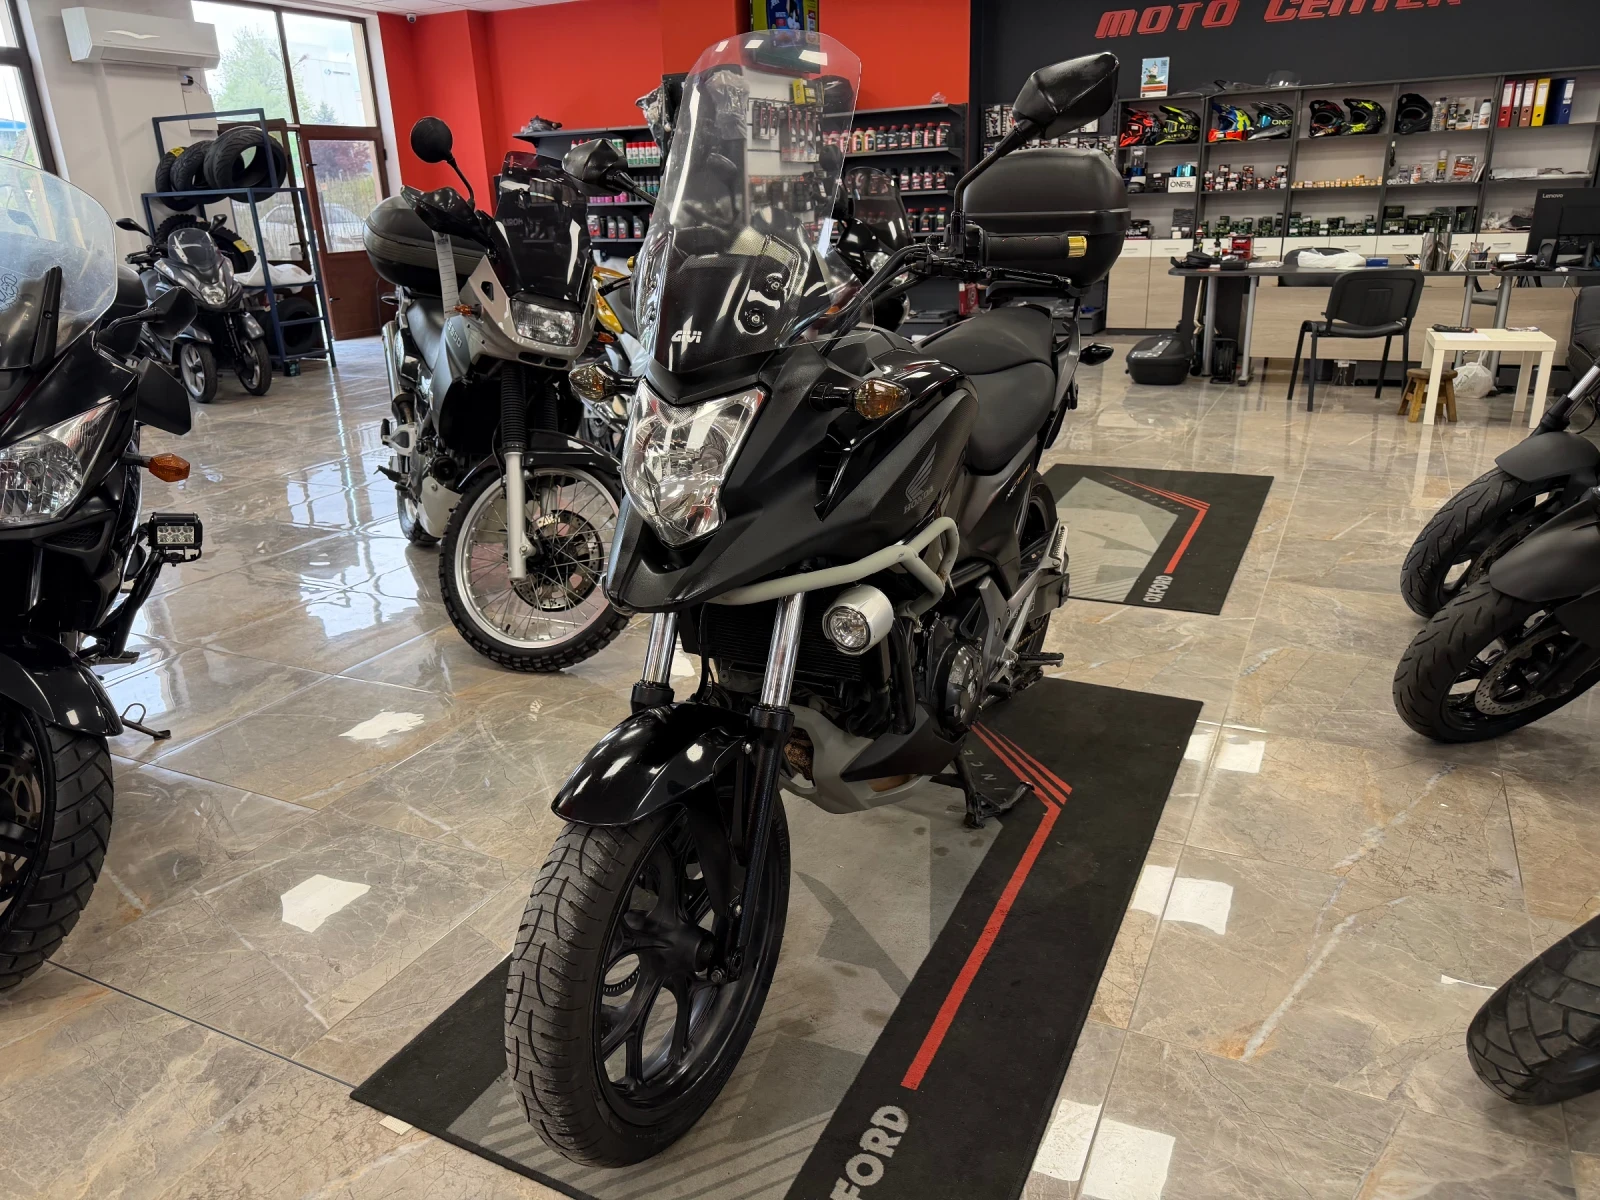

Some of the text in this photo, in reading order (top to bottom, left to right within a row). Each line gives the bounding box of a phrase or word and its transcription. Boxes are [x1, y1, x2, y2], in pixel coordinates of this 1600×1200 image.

[1094, 0, 1241, 39] MOTO
[671, 329, 703, 344] GIVI
[903, 485, 934, 515] HONDA
[1142, 575, 1174, 603] OXFORD
